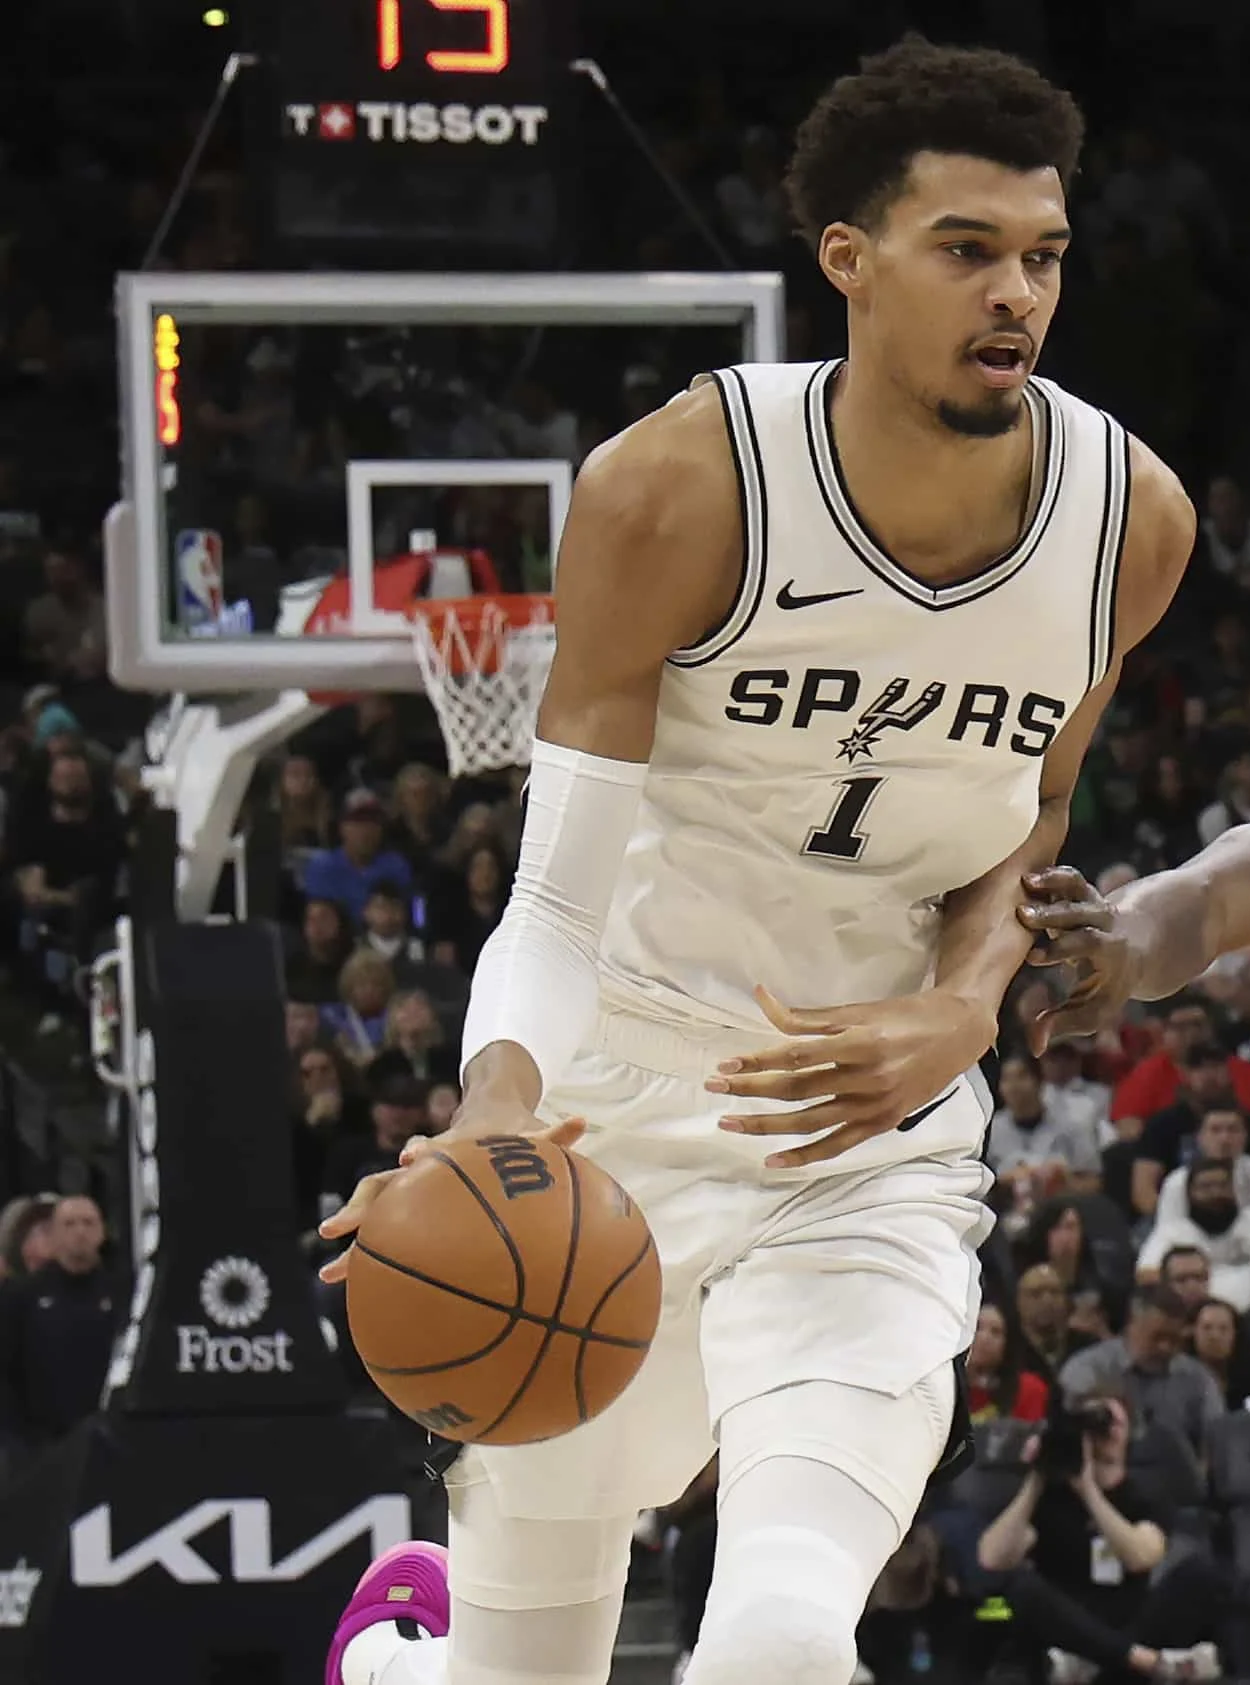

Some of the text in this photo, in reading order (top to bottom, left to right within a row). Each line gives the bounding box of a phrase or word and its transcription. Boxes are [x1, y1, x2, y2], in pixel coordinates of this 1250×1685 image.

[357, 101, 548, 145] TISSOT
[725, 668, 1065, 763] SPURS
[800, 776, 889, 863] 1
[177, 1326, 294, 1373] Frost
[70, 1494, 411, 1587] KIA
